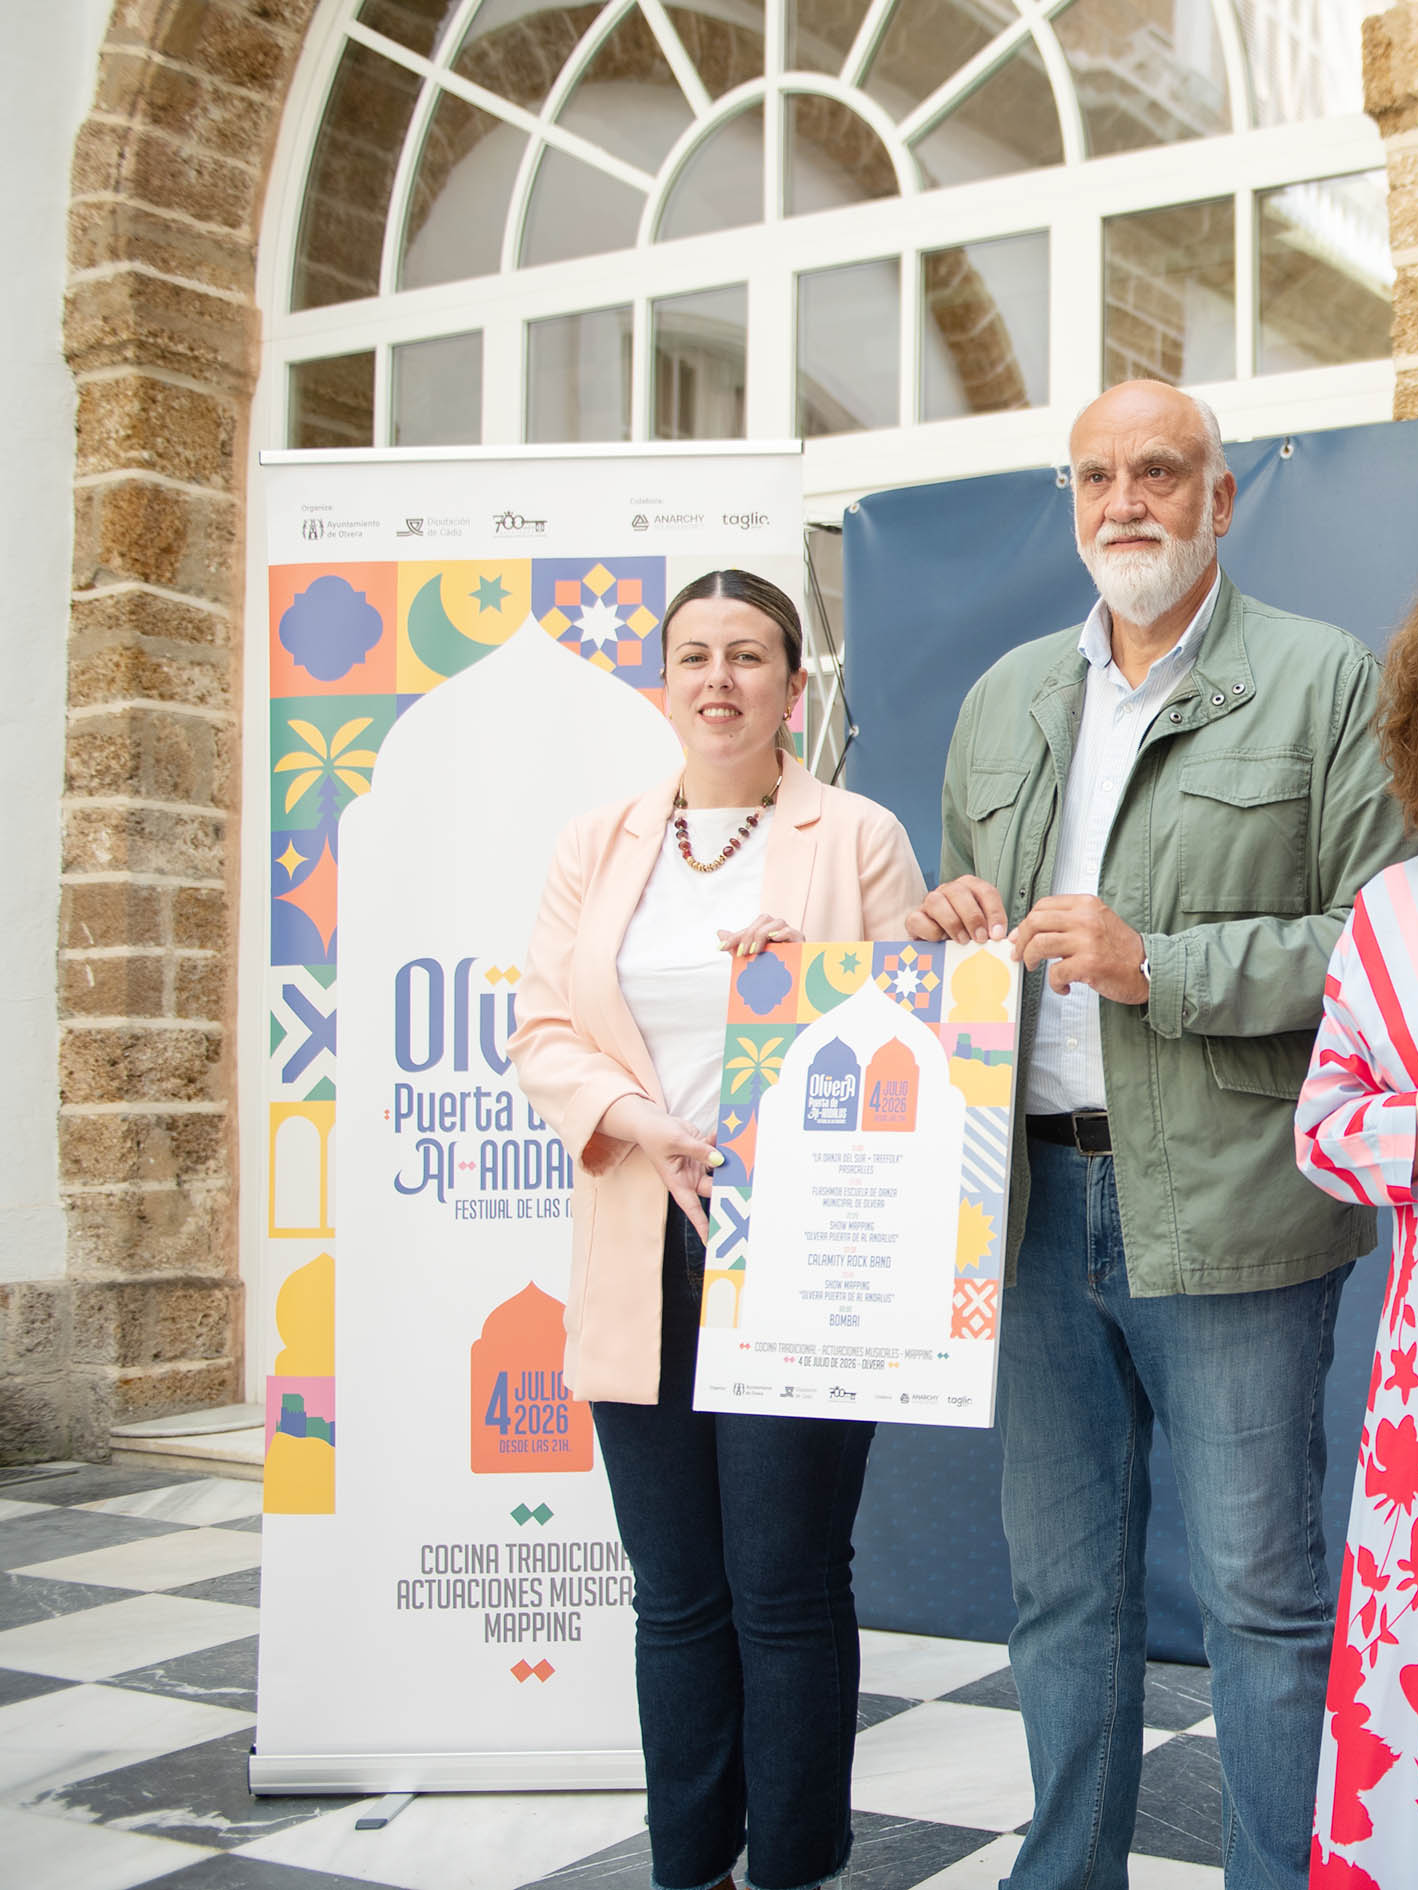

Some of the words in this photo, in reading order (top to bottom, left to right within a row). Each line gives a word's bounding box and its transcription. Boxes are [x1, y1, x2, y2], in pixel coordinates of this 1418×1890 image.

[654, 514, 704, 524] ANARCHY
[395, 1083, 513, 1133] Puerta
[869, 1080, 881, 1112] 4
[480, 1139, 574, 1190] ANDA
[455, 1199, 512, 1220] FESTIVAL
[517, 1199, 532, 1219] DE
[537, 1198, 560, 1218] LAS
[808, 1253, 845, 1267] CALAMITY
[847, 1255, 867, 1268] ROCK
[869, 1255, 891, 1268] BAND
[798, 1356, 803, 1365] 4
[804, 1357, 812, 1366] DE
[813, 1357, 829, 1367] JULIO
[830, 1358, 838, 1367] DE
[839, 1358, 856, 1368] 2026
[862, 1359, 885, 1369] OLVERA
[514, 1371, 569, 1401] JULIO
[485, 1371, 511, 1435] 4
[514, 1404, 569, 1435] 2026
[499, 1439, 529, 1453] DESDE
[531, 1439, 549, 1453] LAS
[421, 1544, 500, 1575] COCINA
[505, 1541, 634, 1573] TRADICIONA
[397, 1577, 543, 1609] ACTUACIONES
[550, 1576, 634, 1607] MUSICA
[484, 1611, 581, 1643] MAPPING
